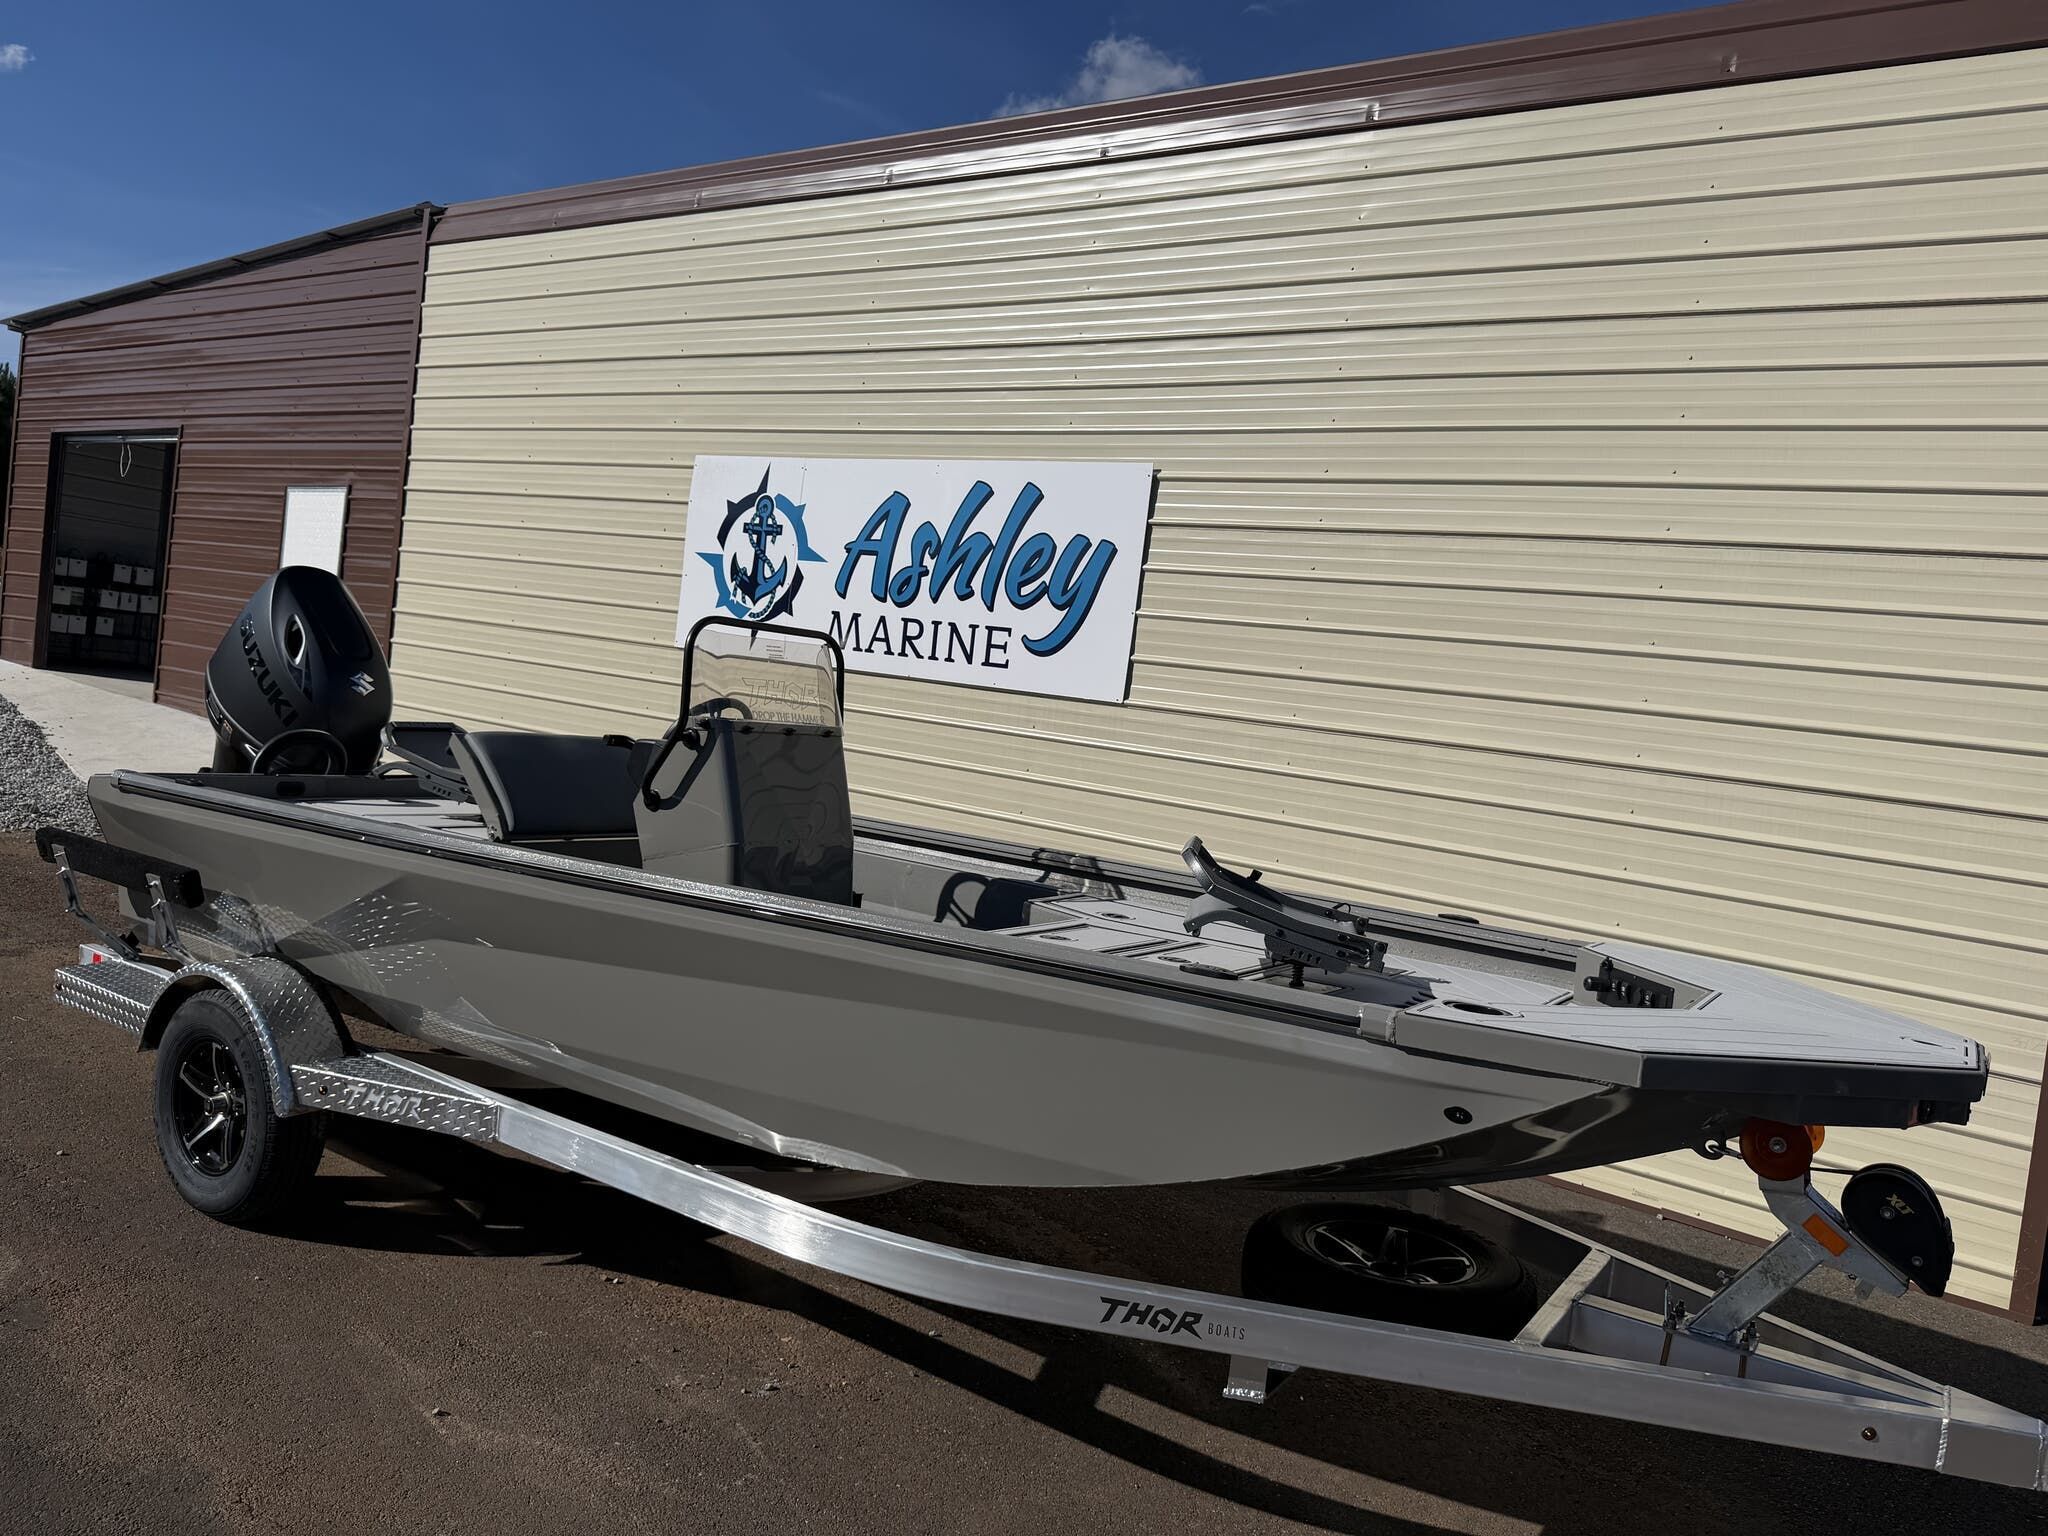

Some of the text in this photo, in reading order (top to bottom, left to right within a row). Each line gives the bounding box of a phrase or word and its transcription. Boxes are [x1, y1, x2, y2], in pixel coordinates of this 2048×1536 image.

[834, 480, 1118, 657] Ashley
[828, 610, 1012, 669] MARINE
[240, 615, 299, 727] SUZUKI
[742, 677, 822, 711] THOR
[752, 711, 775, 721] DROP
[347, 1084, 423, 1120] THOR
[1100, 1296, 1245, 1340] THOR BOATS
